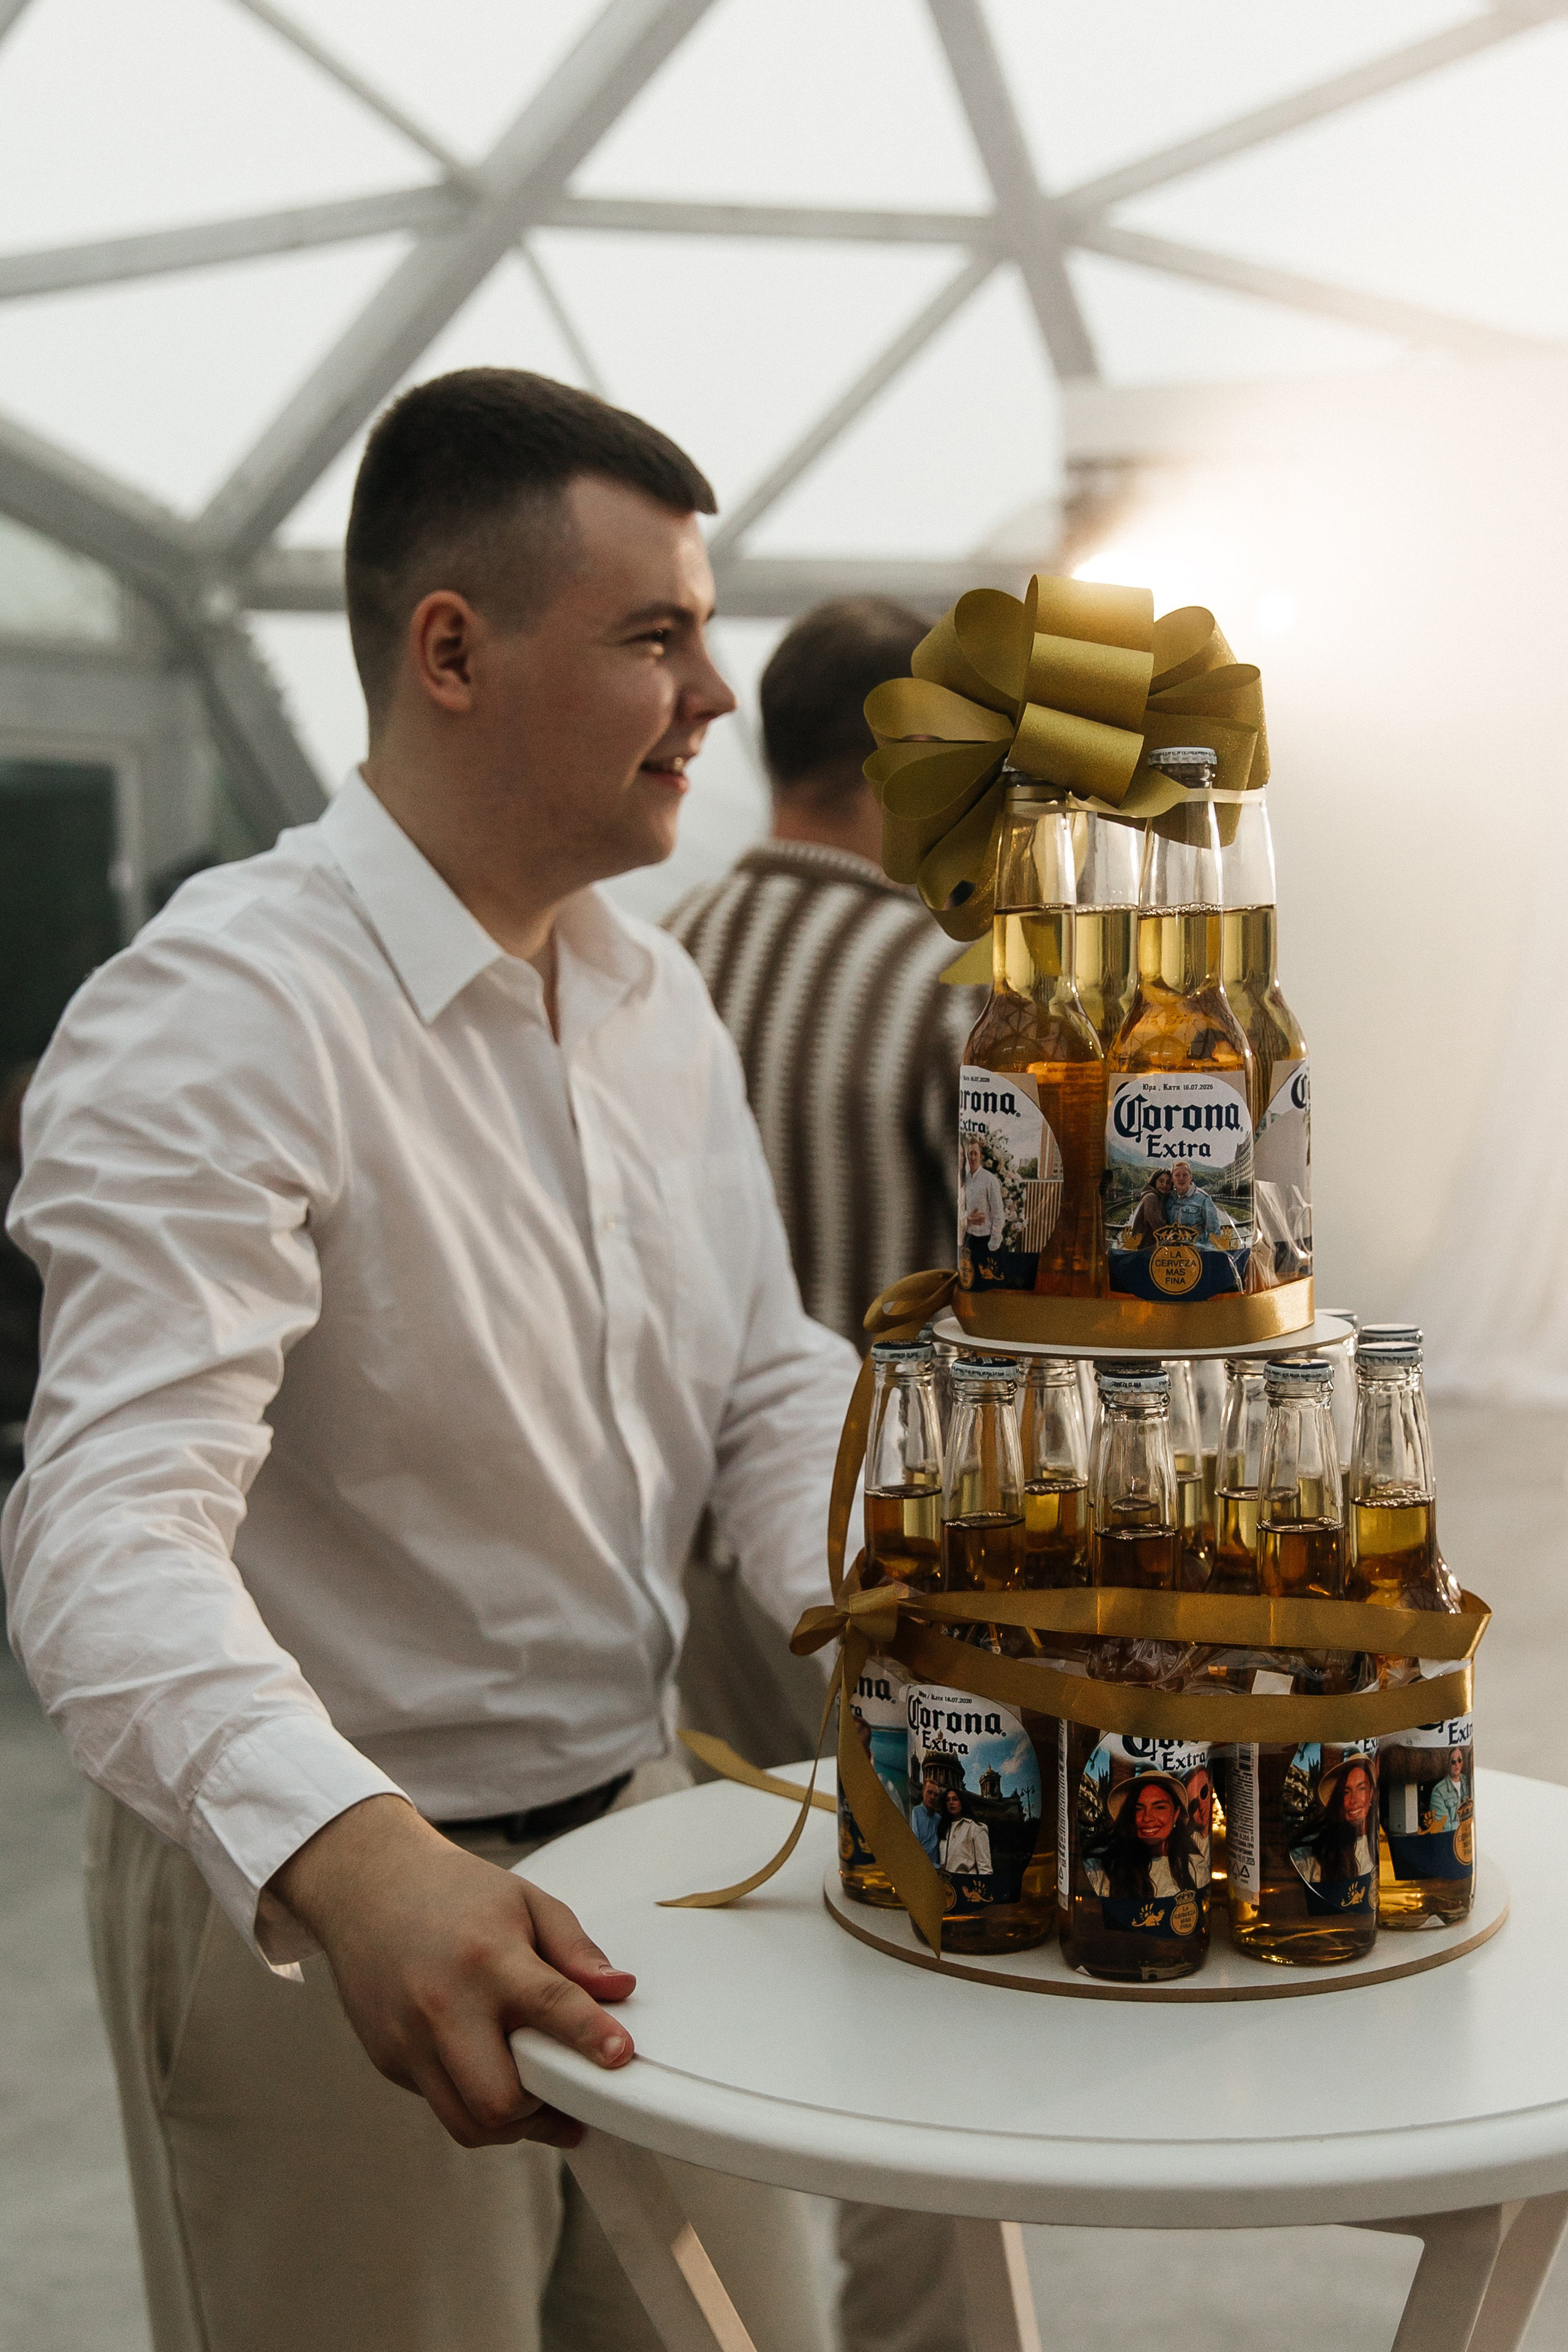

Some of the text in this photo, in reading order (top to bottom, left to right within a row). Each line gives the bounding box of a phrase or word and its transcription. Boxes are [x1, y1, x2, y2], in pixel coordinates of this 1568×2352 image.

[1142, 1083, 1156, 1092] Юра
[960, 1090, 1017, 1115] rona
[1114, 1093, 1240, 1143] Corona
[1146, 1134, 1212, 1158] Extra
[908, 1694, 1003, 1735] Corona
[922, 1729, 969, 1755] Extra
[1161, 1751, 1205, 1771] Extra
